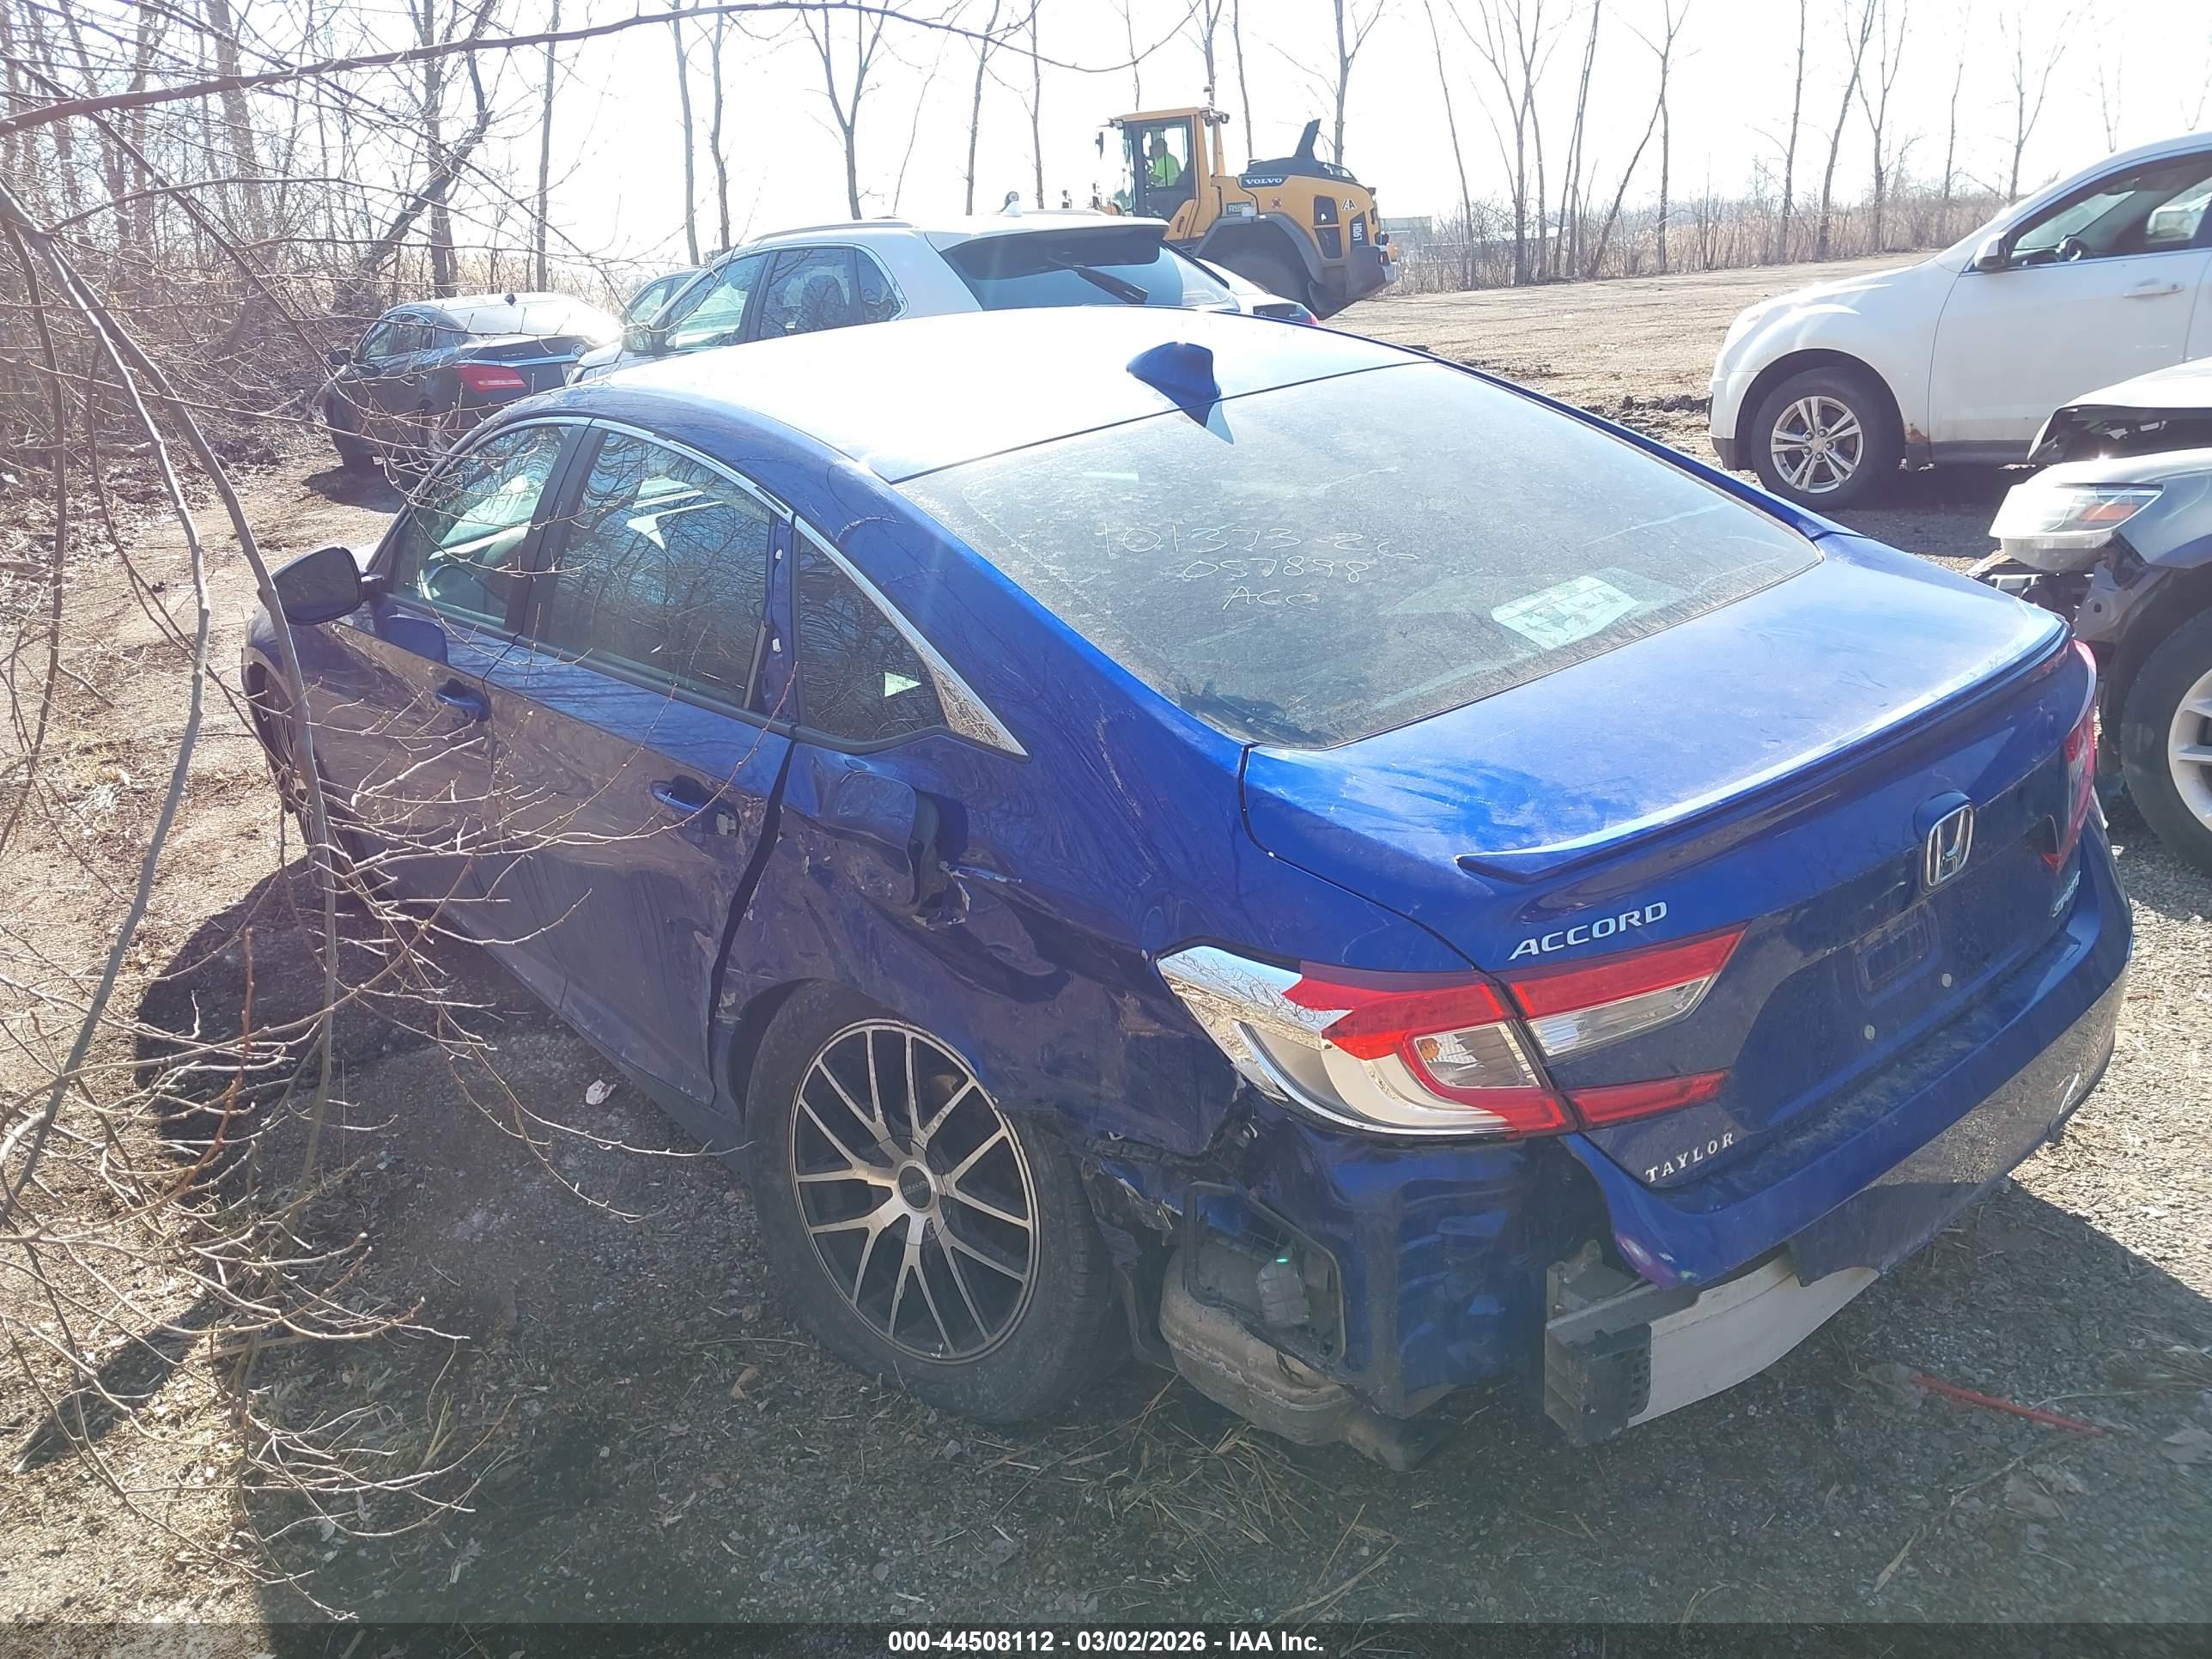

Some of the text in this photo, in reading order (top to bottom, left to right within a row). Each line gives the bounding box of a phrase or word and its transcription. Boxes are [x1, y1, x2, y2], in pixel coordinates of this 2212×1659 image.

[1222, 585, 1319, 610] ACC
[1507, 902, 1668, 962] ACCORD
[1644, 1132, 1735, 1183] TAYLOR
